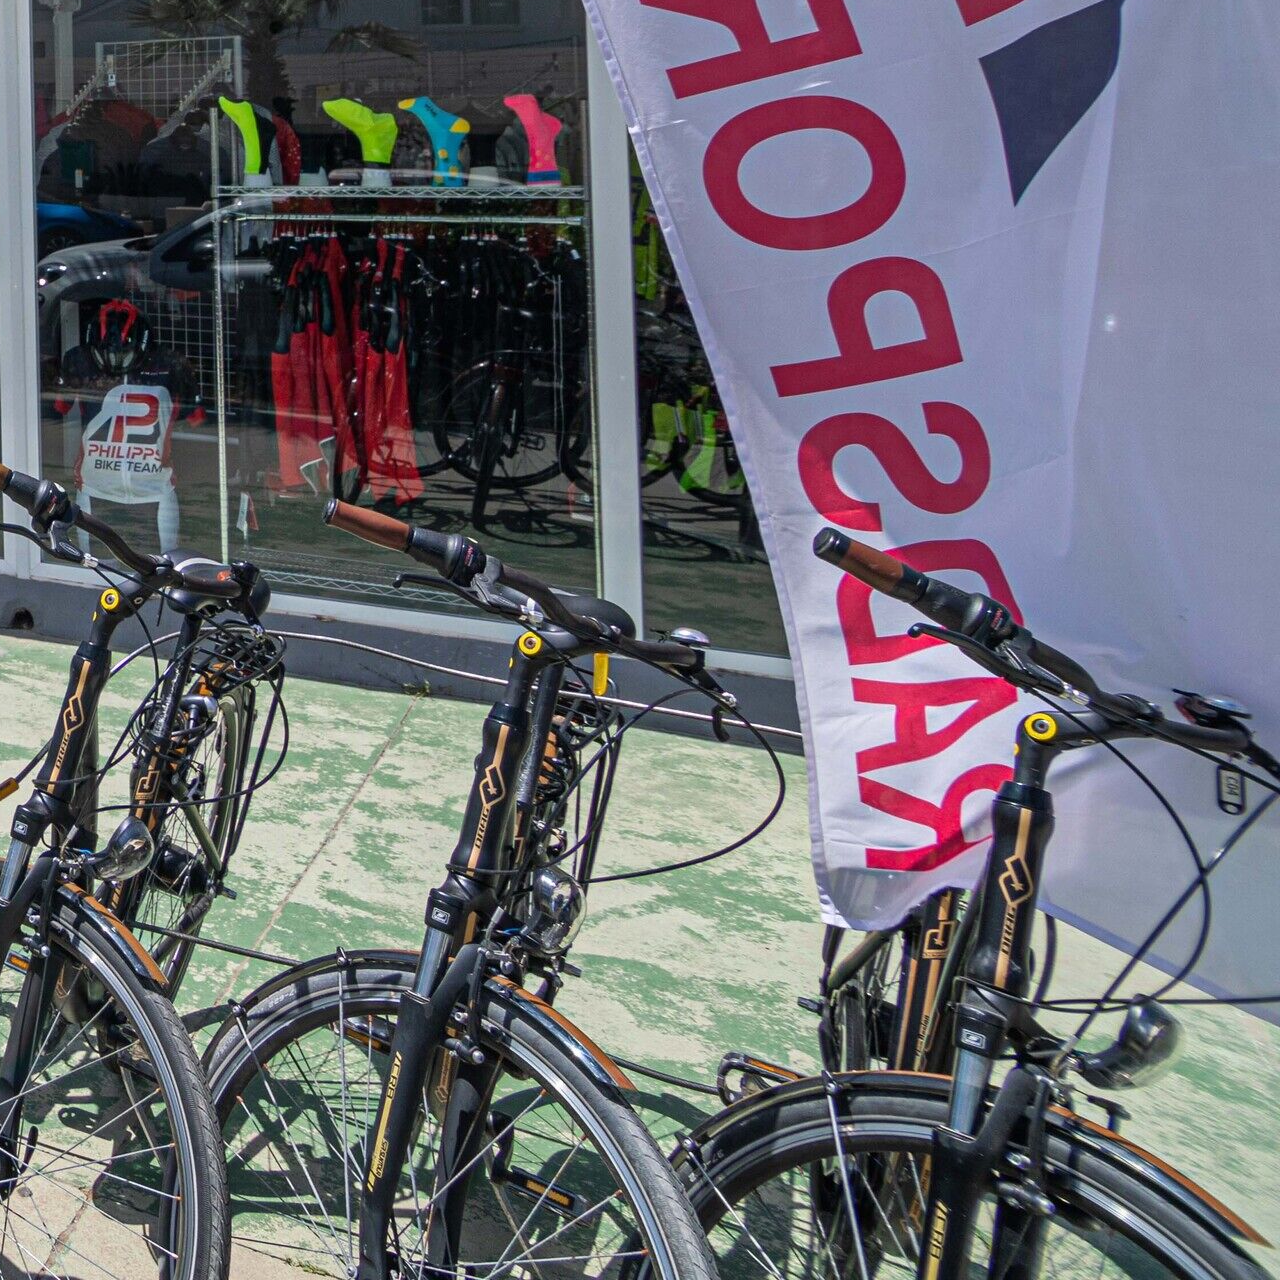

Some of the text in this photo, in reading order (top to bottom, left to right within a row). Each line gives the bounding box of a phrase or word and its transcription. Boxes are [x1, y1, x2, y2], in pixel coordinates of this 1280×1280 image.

[94, 459, 163, 473] BIKE TEAM
[474, 805, 491, 850] DRAG
